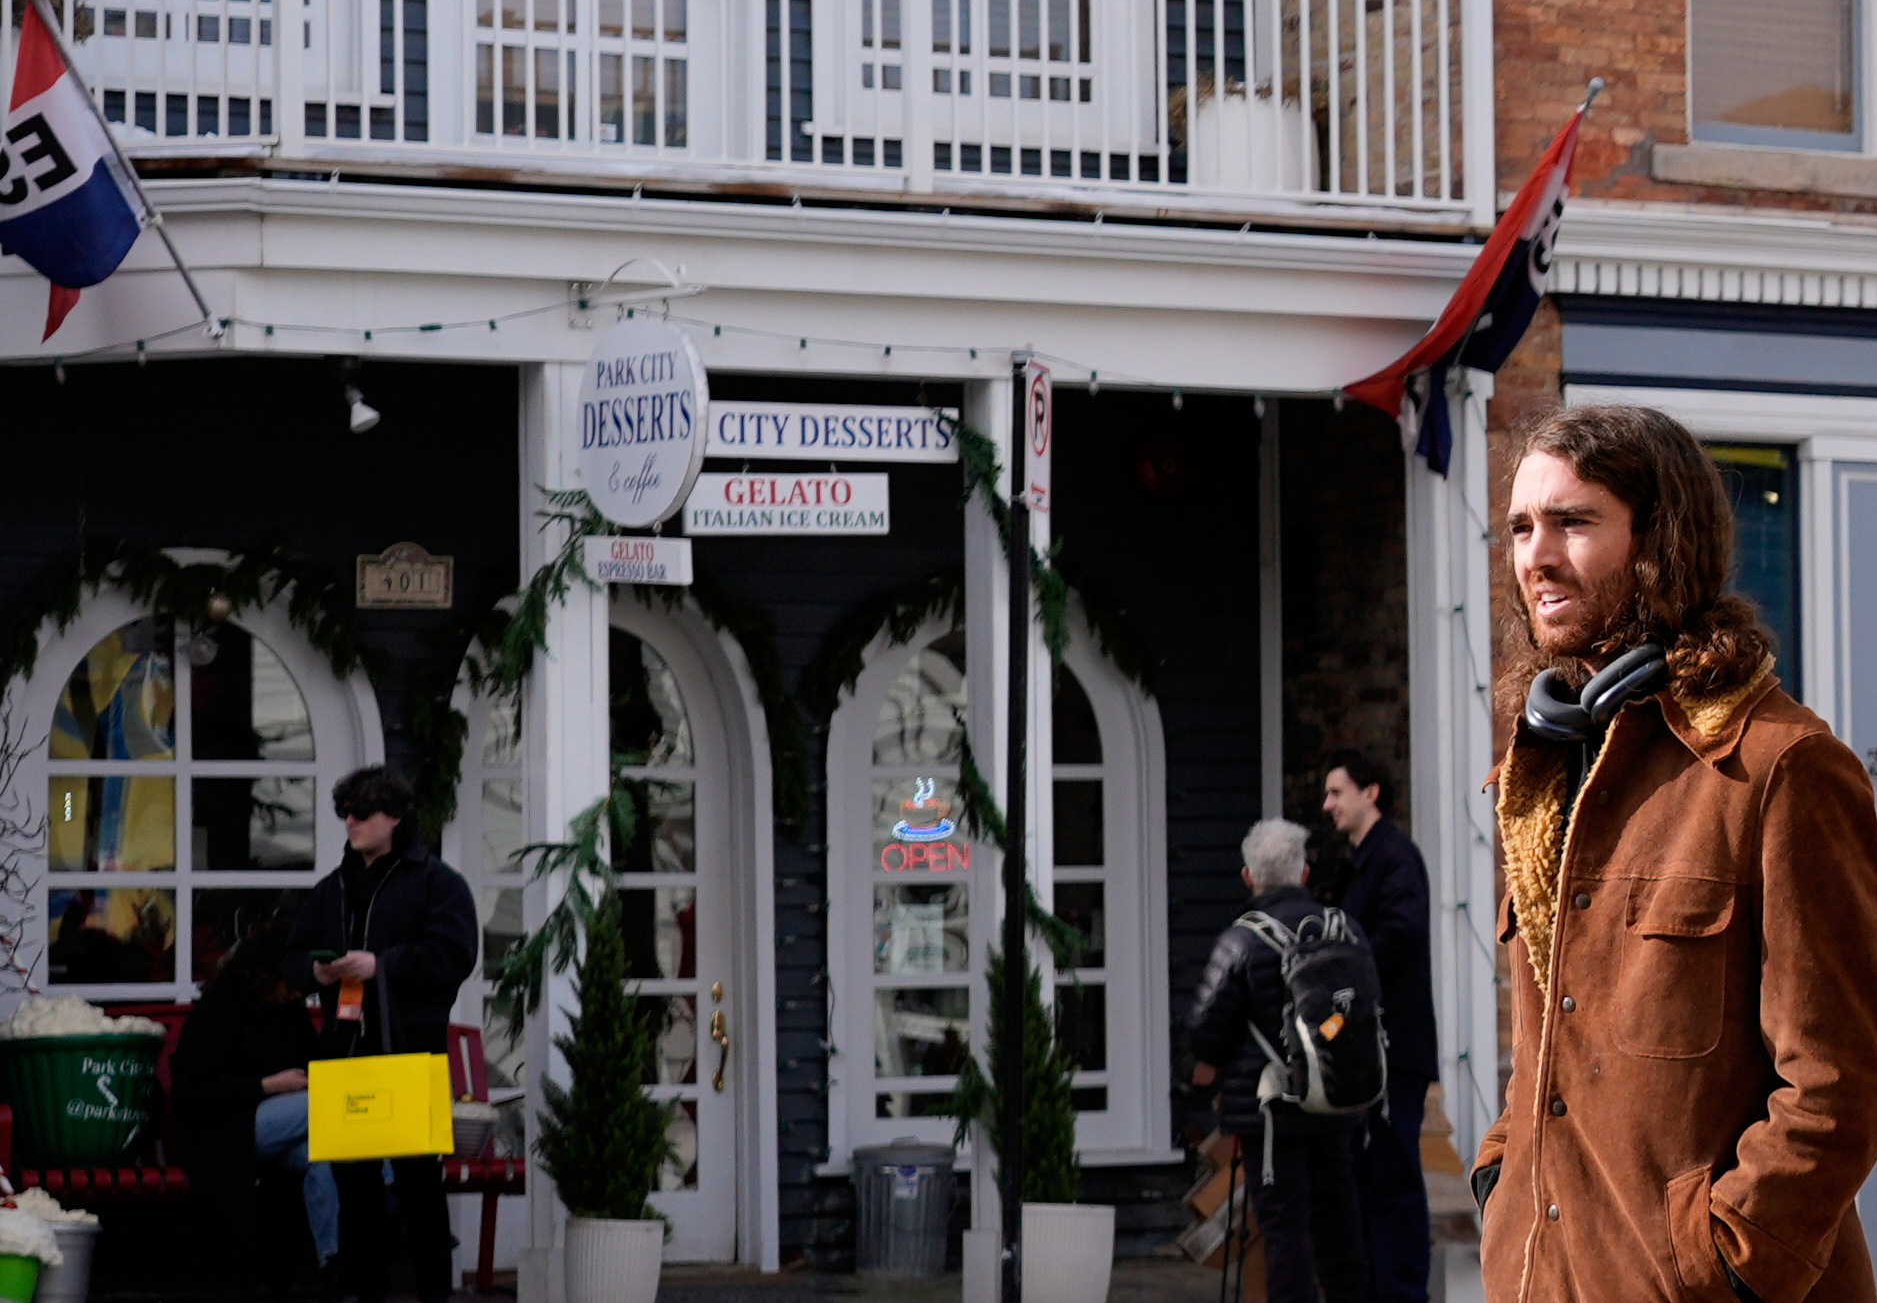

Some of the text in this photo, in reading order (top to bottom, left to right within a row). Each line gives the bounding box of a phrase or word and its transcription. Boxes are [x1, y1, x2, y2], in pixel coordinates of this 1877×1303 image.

[596, 350, 678, 390] PARK CITY
[582, 389, 692, 449] DESSERTS
[719, 411, 951, 449] CITY DESSERTS
[624, 452, 661, 504] coffee
[724, 478, 852, 507] GELATO
[693, 509, 885, 528] ITALIAN ICE CREAM
[611, 539, 655, 562] GELATO
[597, 560, 667, 580] ESPRESSO BAR
[881, 841, 971, 872] OPEN
[81, 1056, 115, 1076] Park
